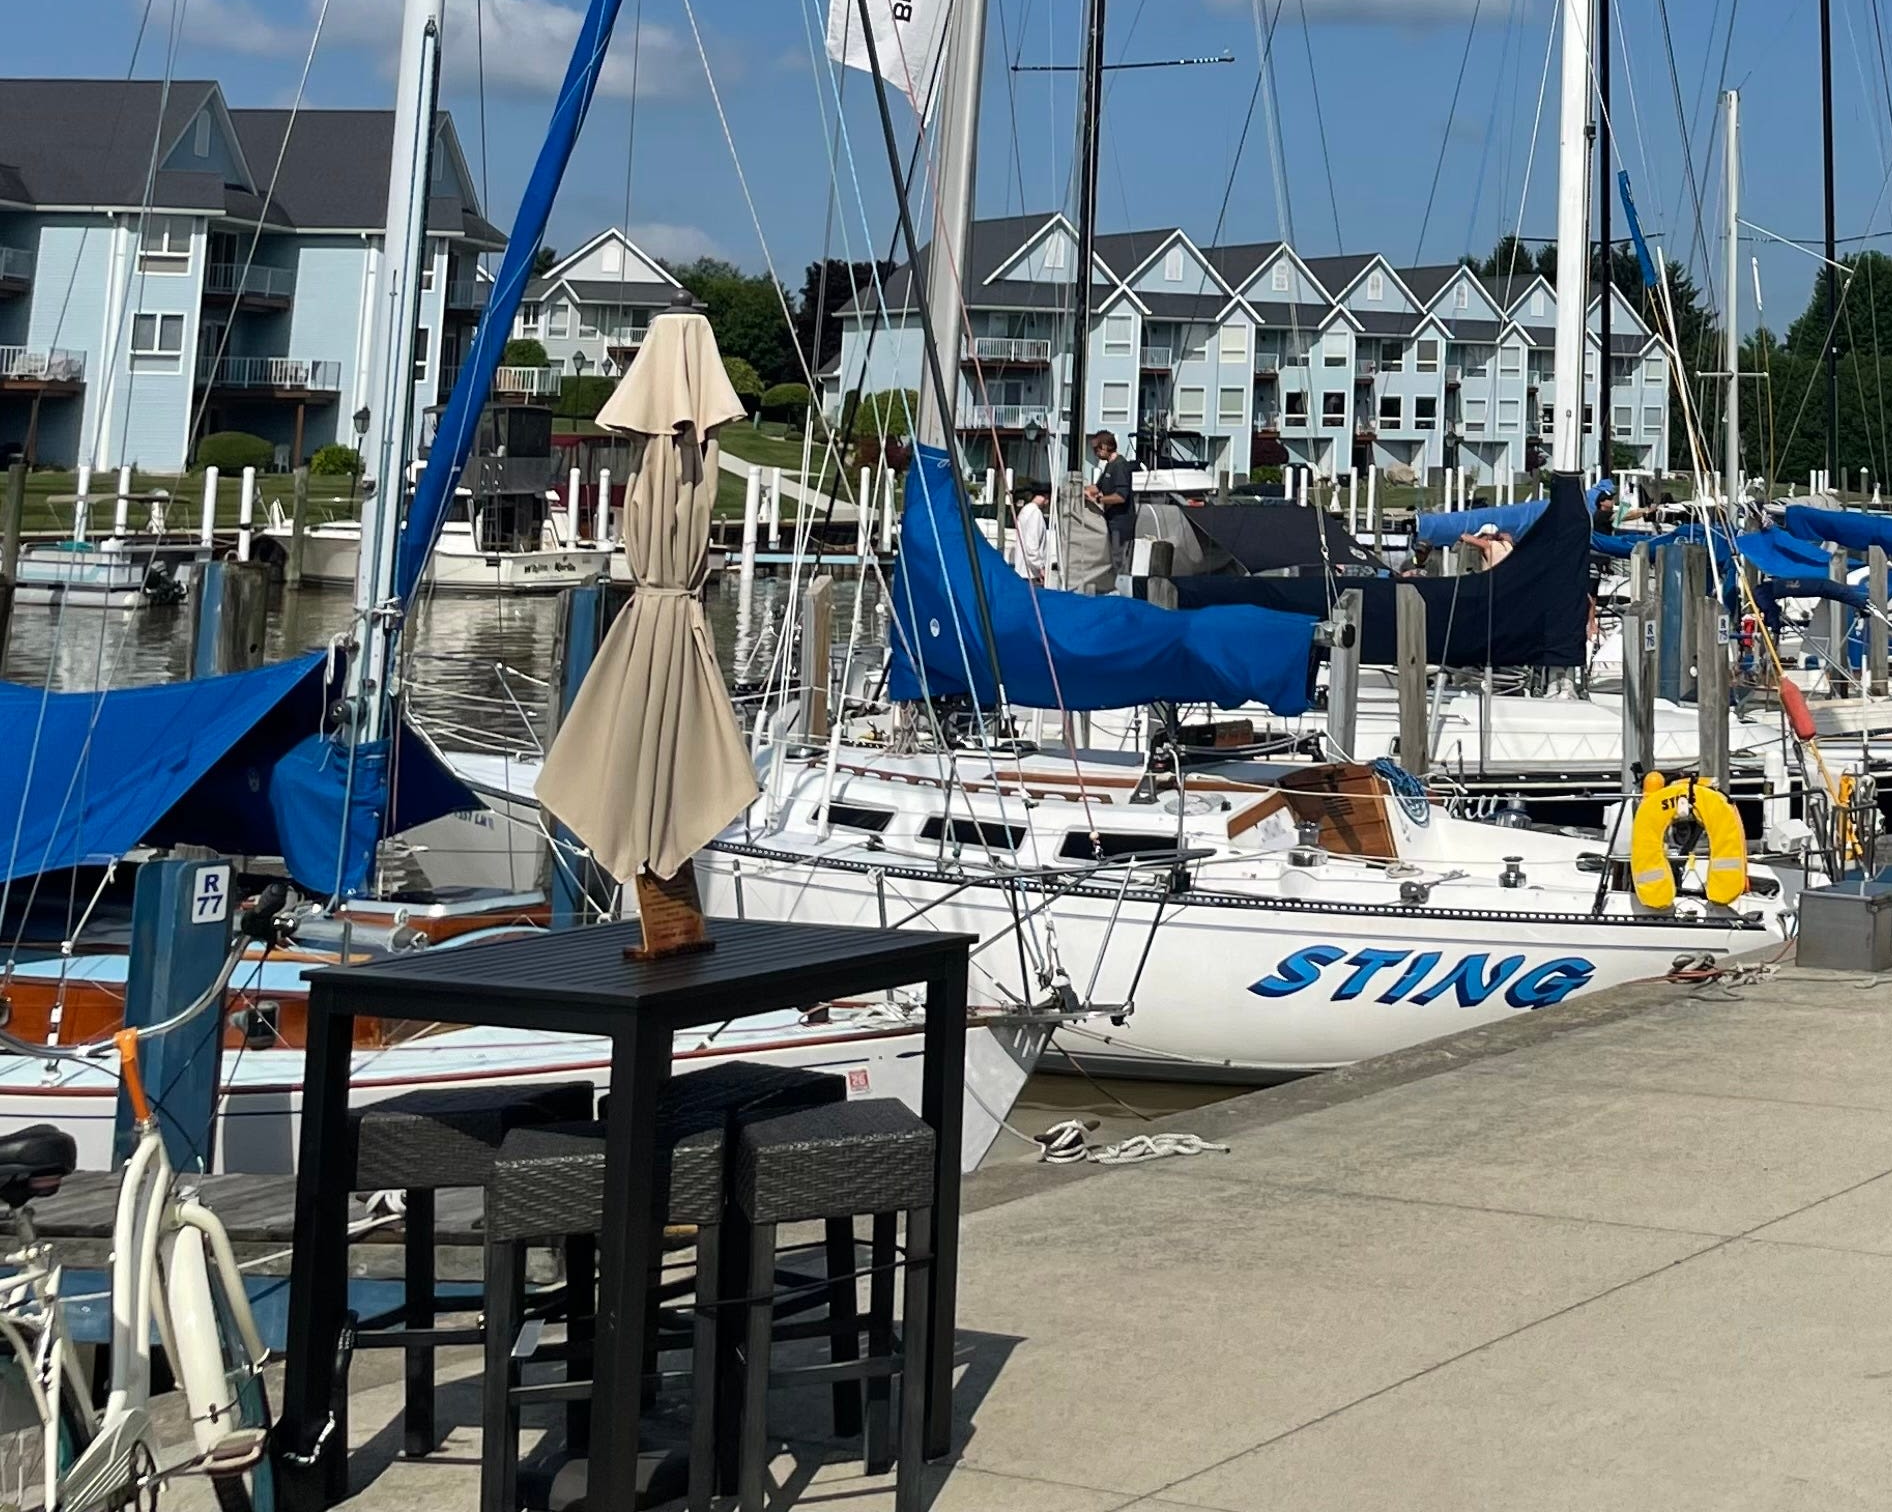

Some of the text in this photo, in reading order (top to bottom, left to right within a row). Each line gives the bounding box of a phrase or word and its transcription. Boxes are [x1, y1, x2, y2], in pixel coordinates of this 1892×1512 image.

[1647, 624, 1654, 635] R
[204, 874, 220, 894] R
[197, 894, 224, 916] 77
[1246, 944, 1597, 1010] STING
